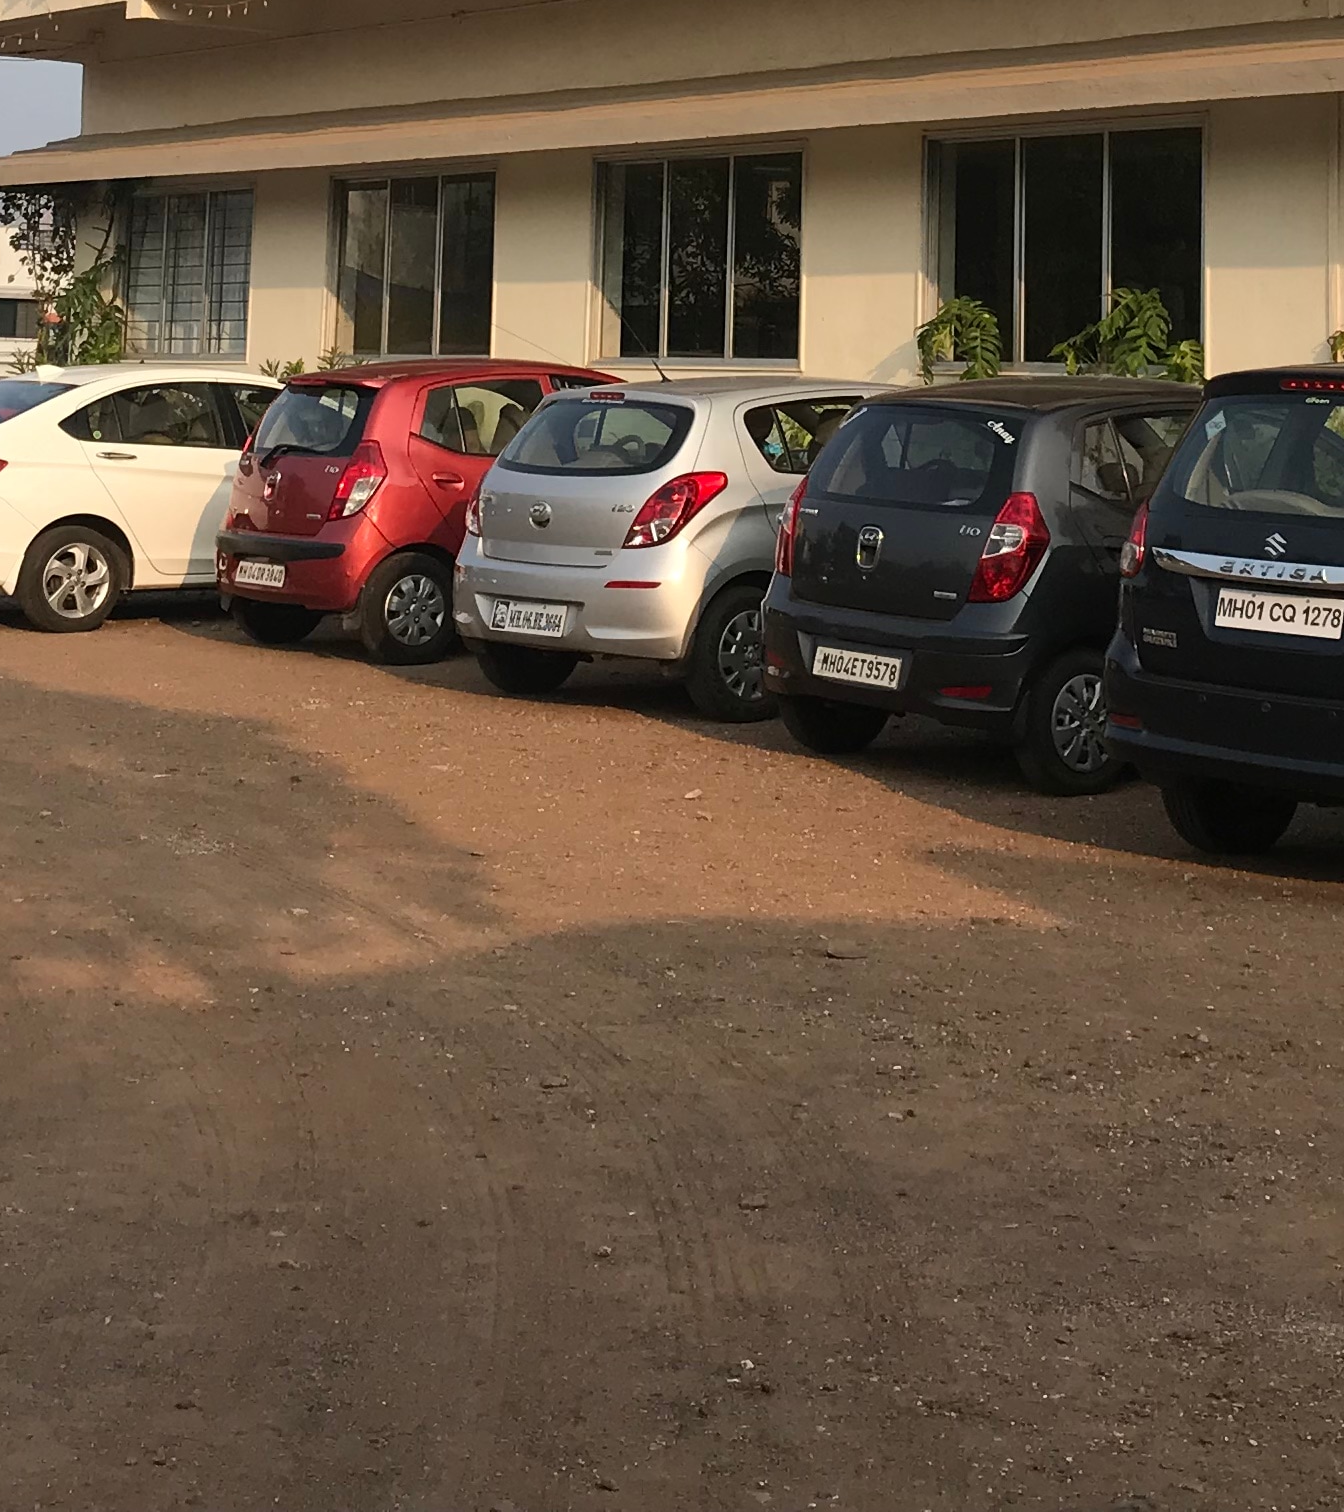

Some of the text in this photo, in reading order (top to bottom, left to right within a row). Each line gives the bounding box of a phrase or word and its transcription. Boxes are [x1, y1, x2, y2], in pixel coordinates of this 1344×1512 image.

[1219, 561, 1328, 584] ERTIGA
[1217, 596, 1343, 629] MH01 CQ 1278
[820, 652, 898, 683] MH04ET9578
